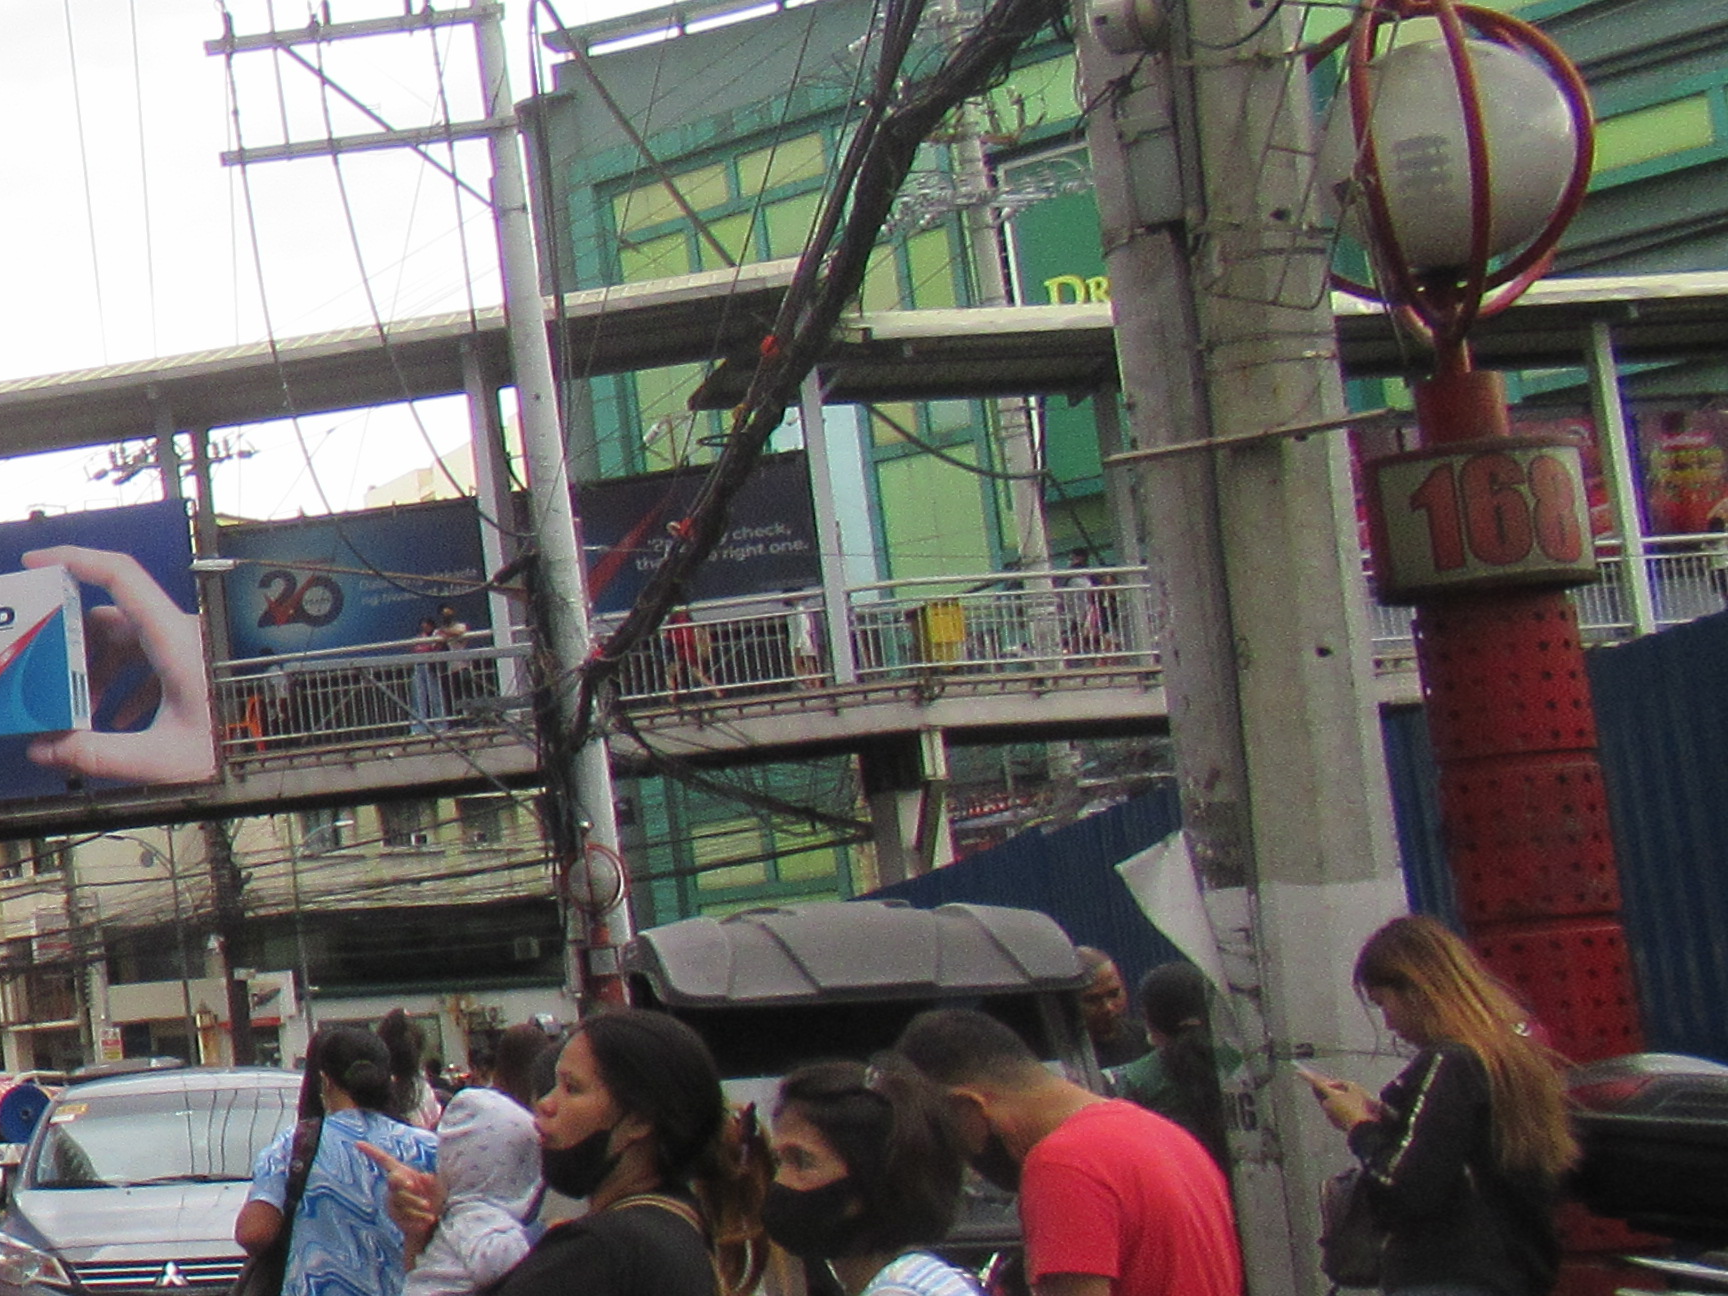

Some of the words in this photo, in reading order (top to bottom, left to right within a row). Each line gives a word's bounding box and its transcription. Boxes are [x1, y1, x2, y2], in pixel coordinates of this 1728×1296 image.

[731, 522, 792, 541] check,
[1409, 454, 1583, 571] 168
[722, 542, 765, 563] right
[258, 569, 344, 628] 20
